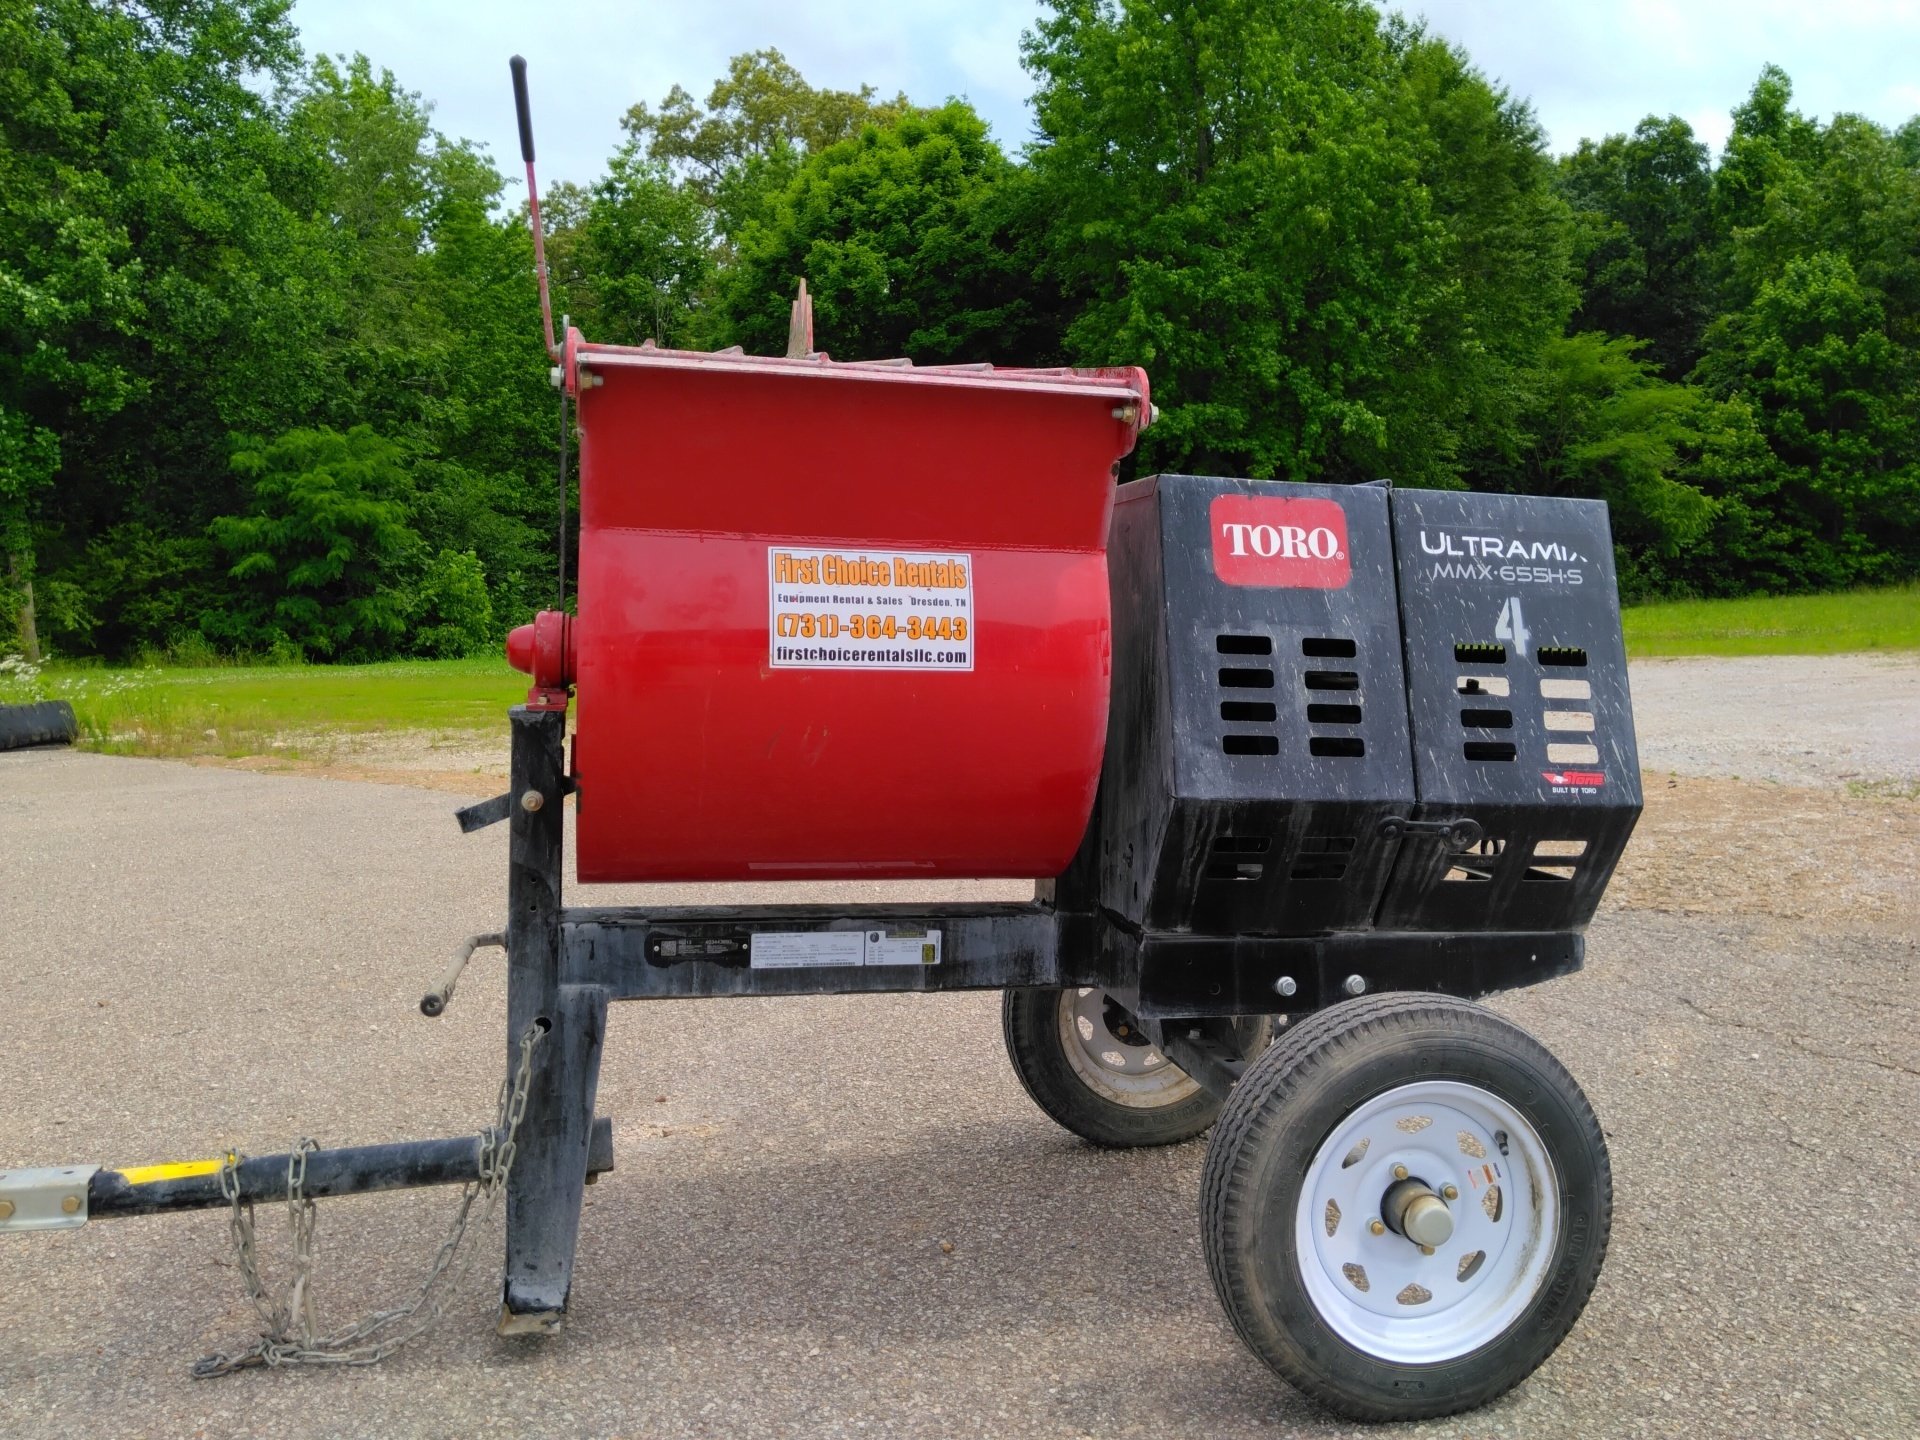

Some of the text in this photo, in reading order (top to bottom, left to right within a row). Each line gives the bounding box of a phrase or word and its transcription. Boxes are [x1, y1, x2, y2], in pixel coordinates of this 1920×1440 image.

[775, 552, 968, 589] First Choice Rentals
[777, 593, 830, 604] Equipment
[832, 593, 865, 605] Rental
[867, 597, 873, 605] &
[876, 596, 903, 605] Sales
[955, 598, 967, 607] TN
[777, 612, 968, 641] (731)-364-3443
[1495, 596, 1530, 656] 4
[776, 646, 967, 664] firstchoicerentalsllc.com
